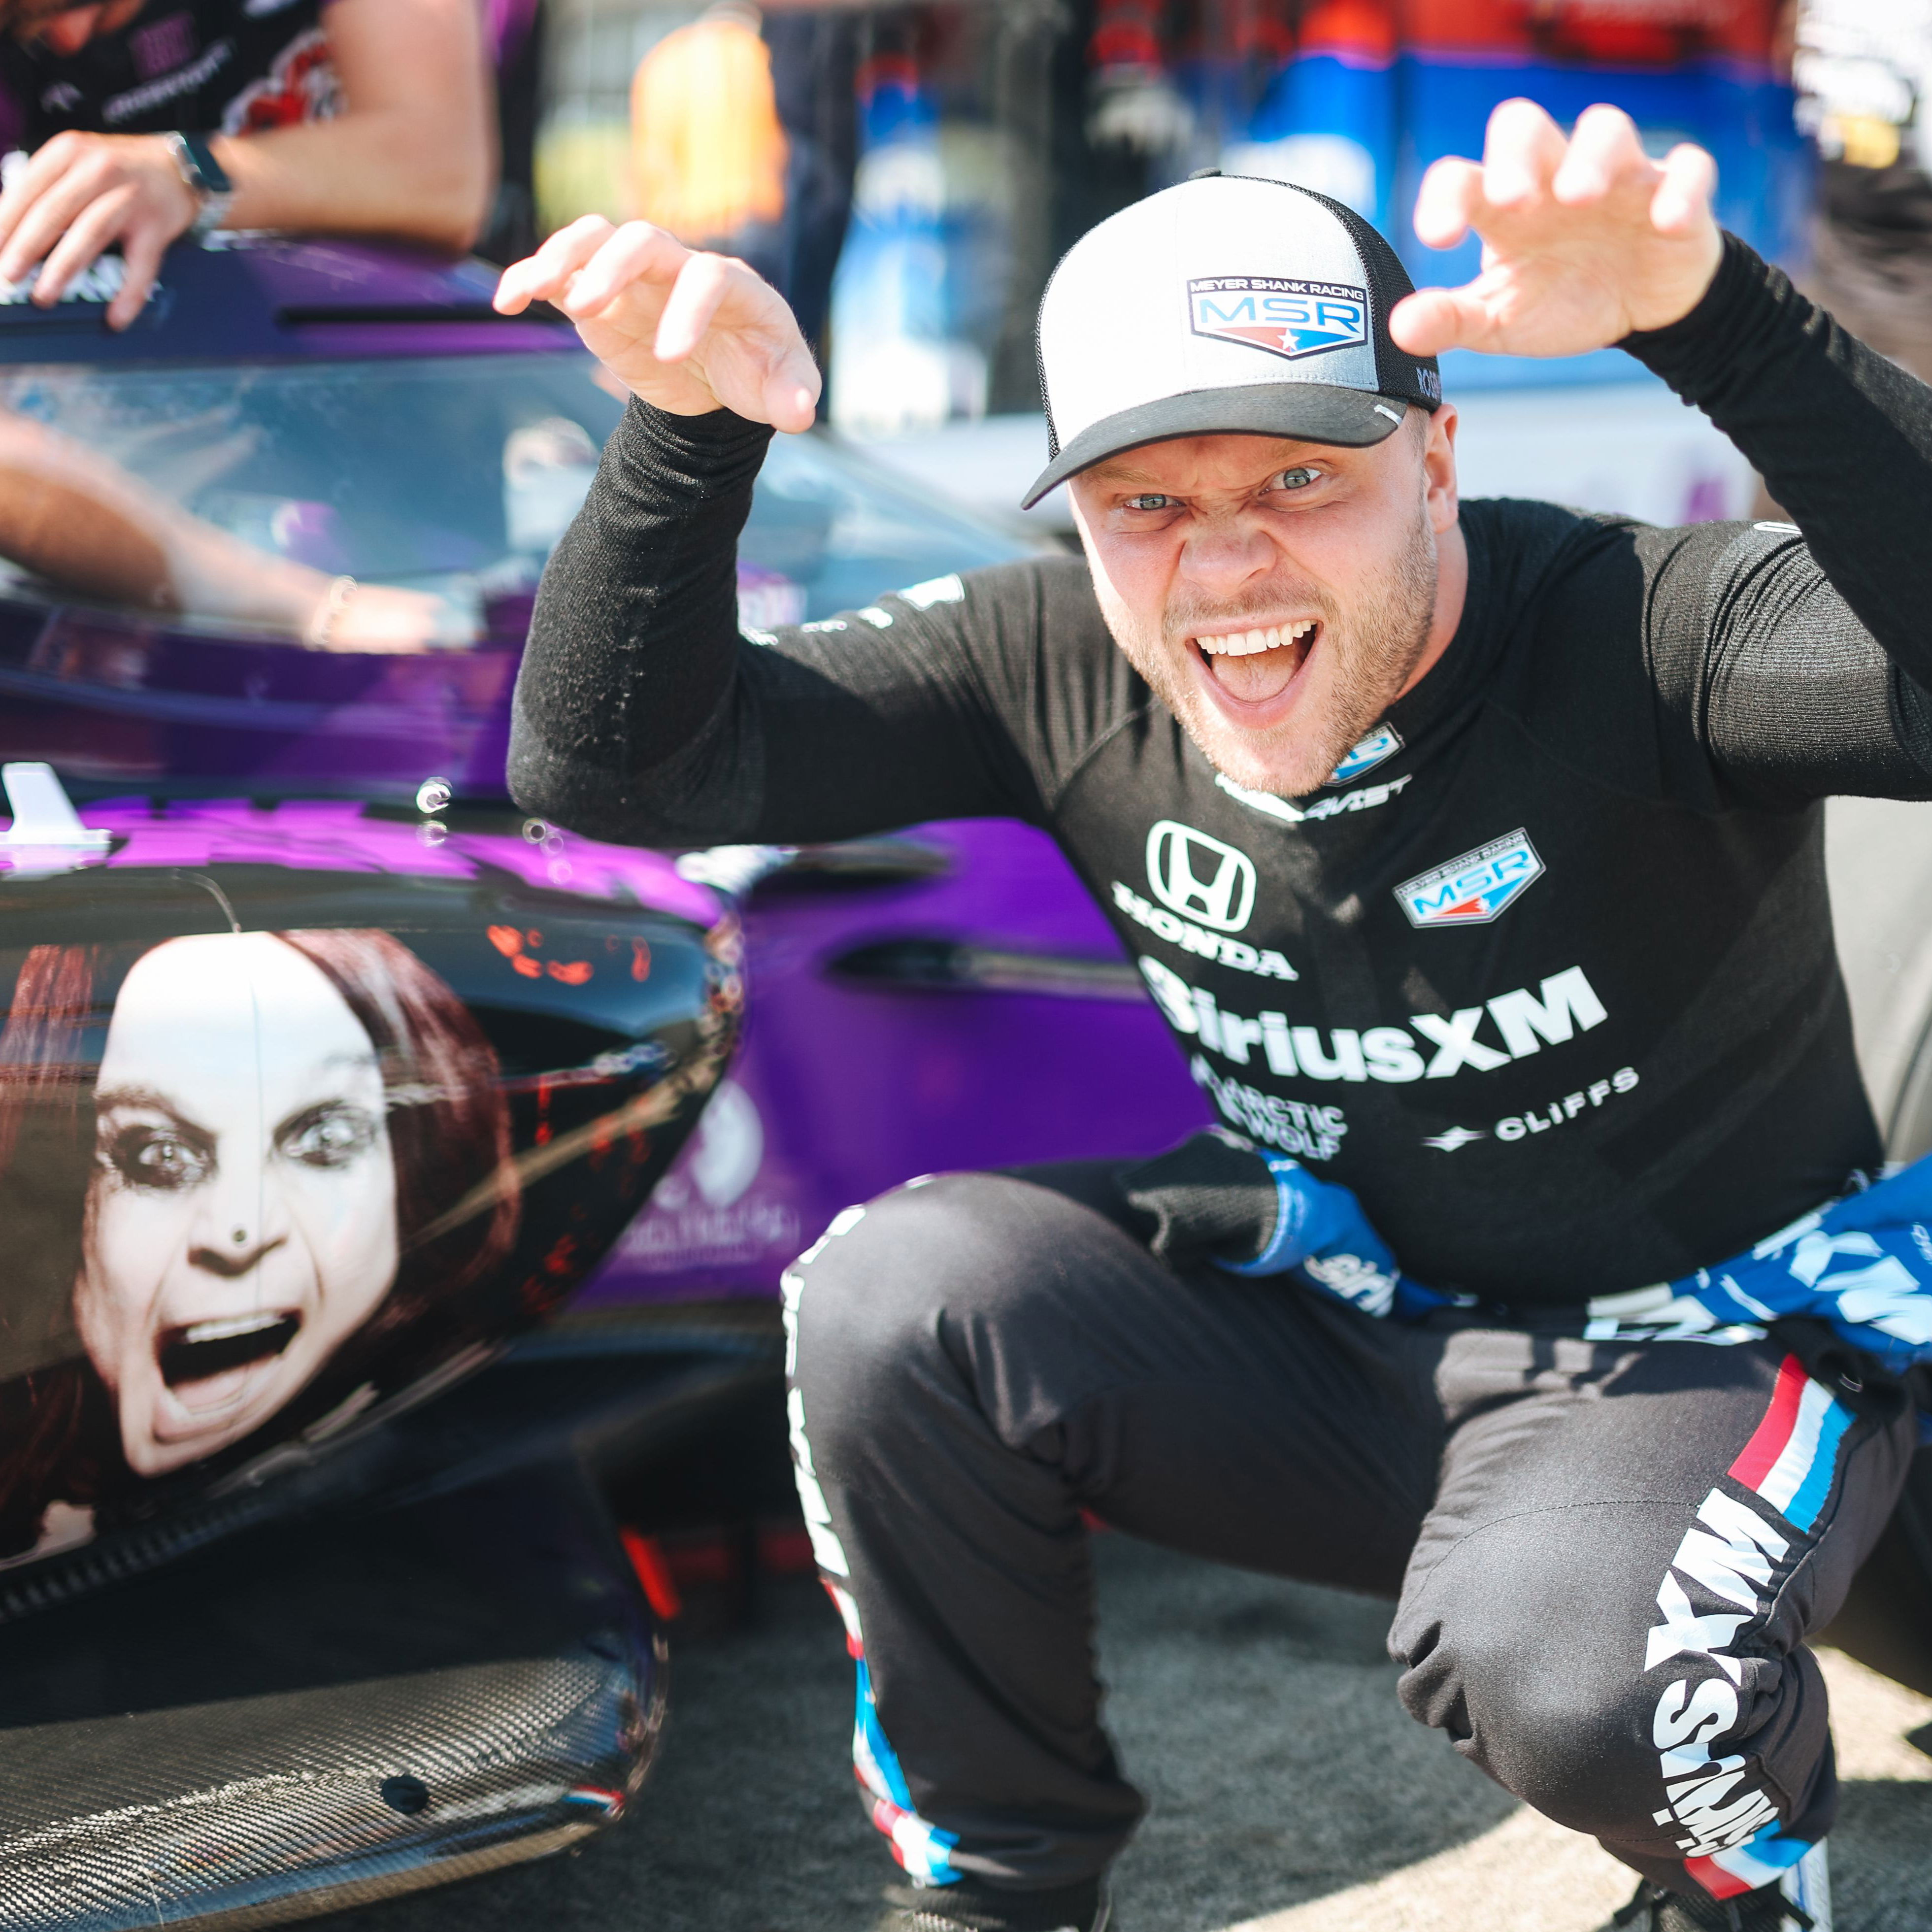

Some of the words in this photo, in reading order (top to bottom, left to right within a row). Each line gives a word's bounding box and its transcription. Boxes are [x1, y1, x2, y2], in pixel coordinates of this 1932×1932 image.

[1190, 279, 1248, 292] MEYER
[1251, 279, 1307, 293] SHANK
[1309, 284, 1364, 301] RACING
[1199, 297, 1362, 334] MSR
[1412, 851, 1529, 914] MSR
[1111, 880, 1299, 981] HONDA
[1138, 954, 1608, 1083] SiriusXM
[1224, 1077, 1348, 1135] ARCTIC
[1495, 1066, 1639, 1141] CLIFFS
